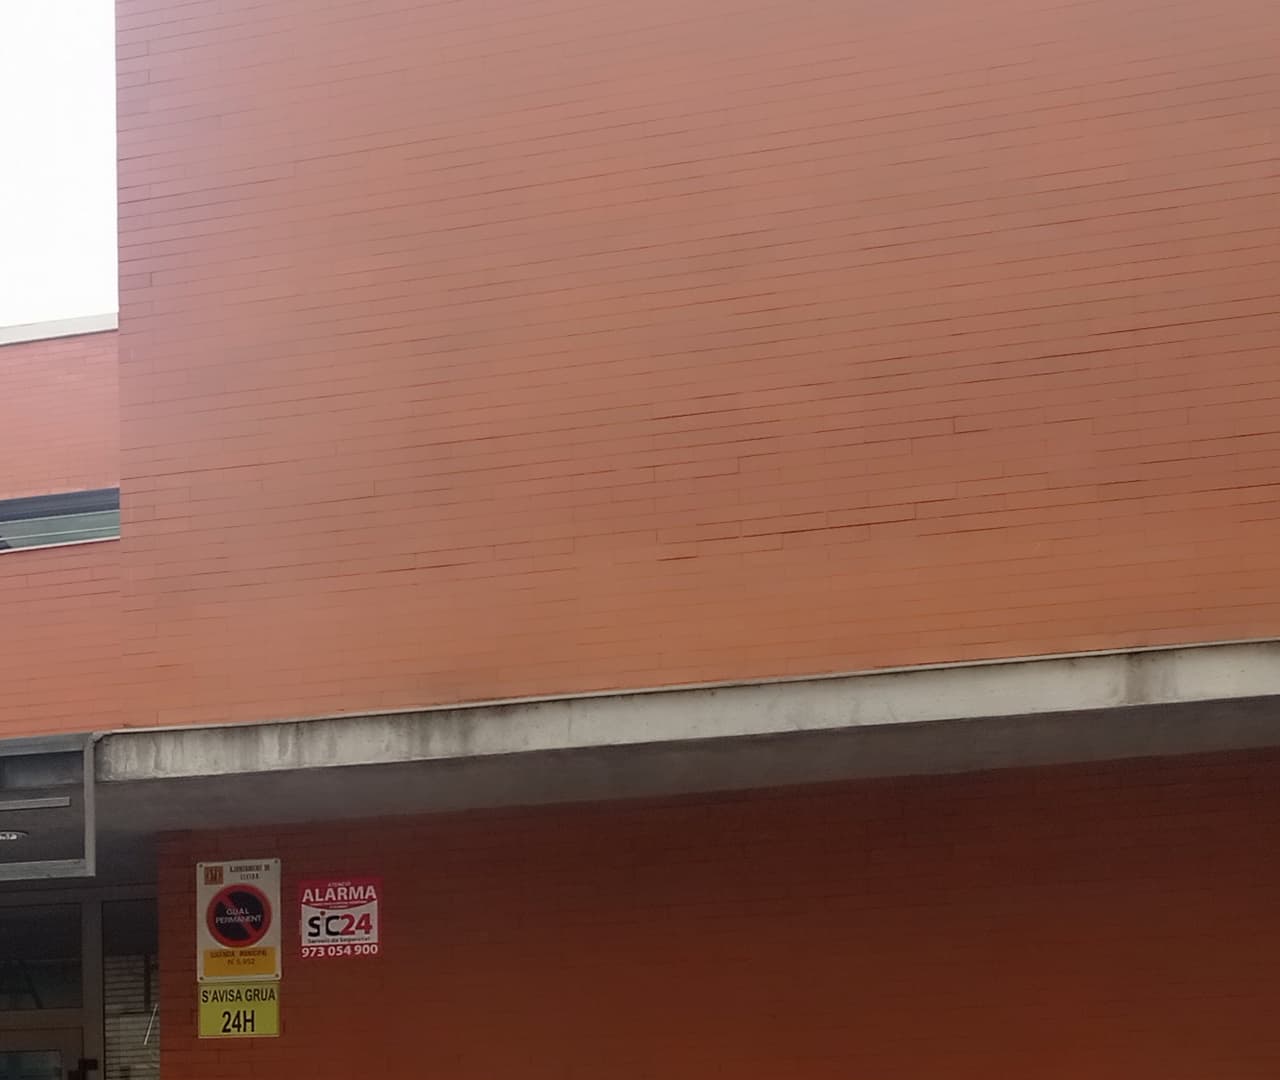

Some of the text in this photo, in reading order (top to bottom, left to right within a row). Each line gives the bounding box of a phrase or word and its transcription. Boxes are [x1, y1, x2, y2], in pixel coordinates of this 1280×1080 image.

[302, 885, 377, 902] ALARMA
[216, 914, 263, 925] PERMANENT
[301, 944, 378, 958] 973 054 900
[202, 987, 276, 1003] S'AVISA GRUA
[222, 1010, 255, 1033] 24H
